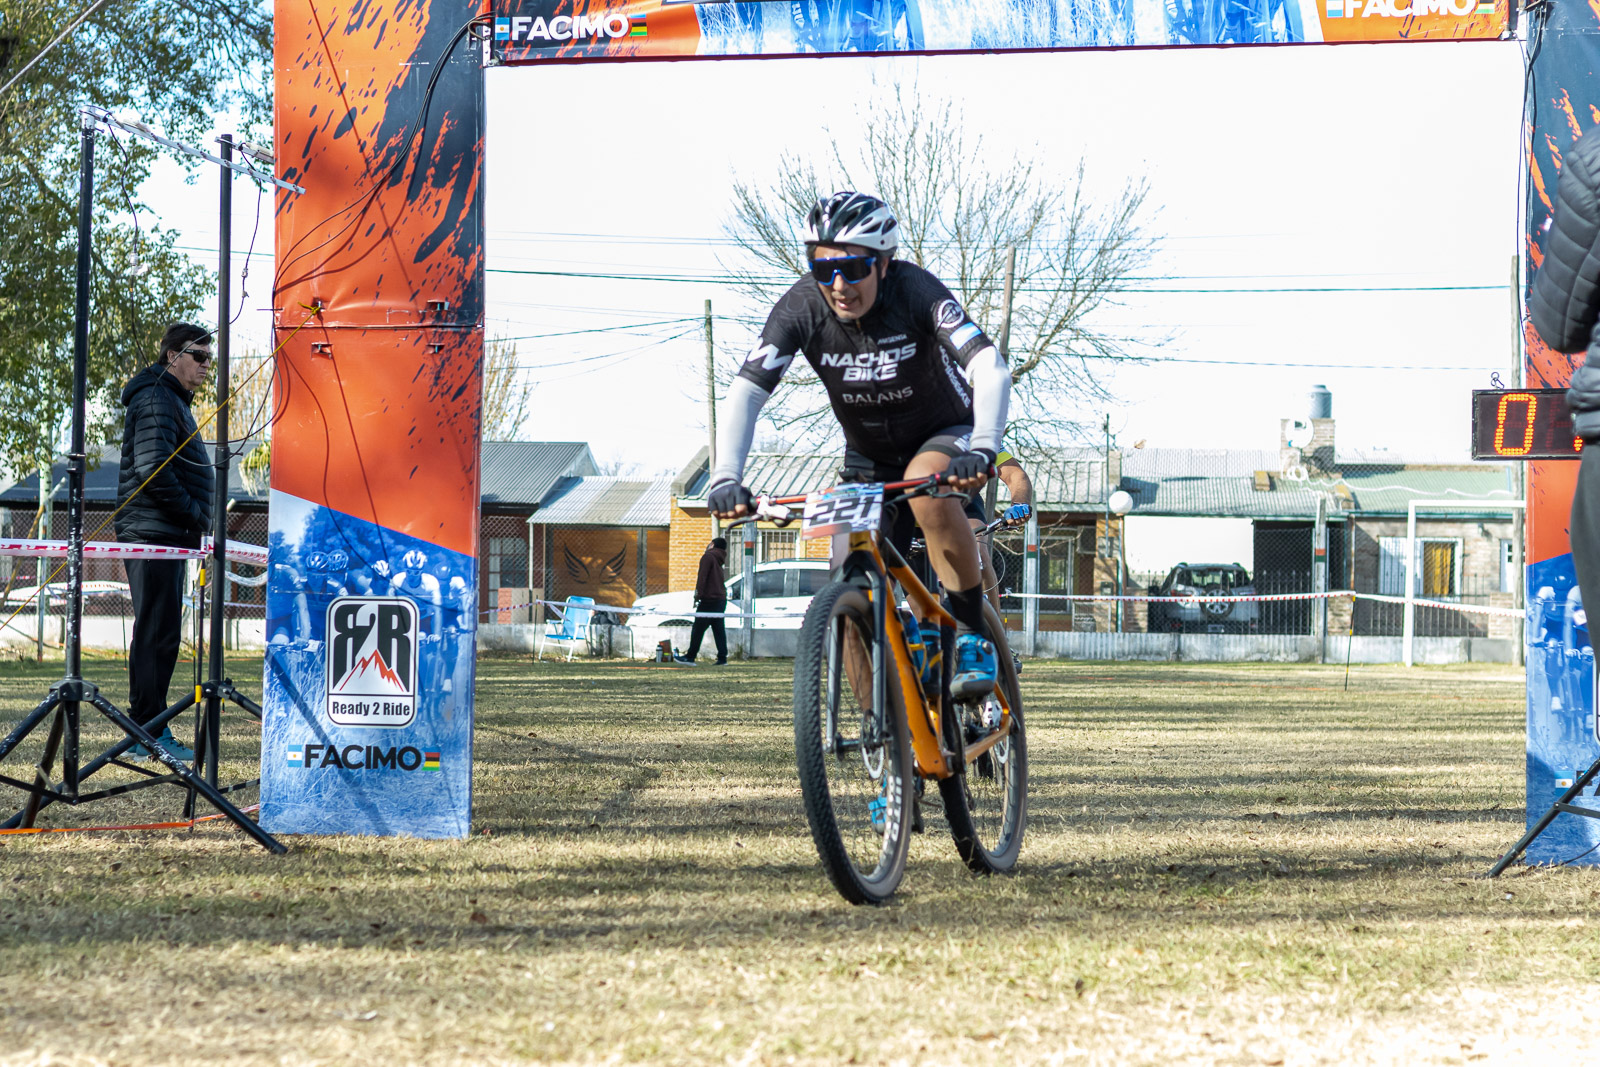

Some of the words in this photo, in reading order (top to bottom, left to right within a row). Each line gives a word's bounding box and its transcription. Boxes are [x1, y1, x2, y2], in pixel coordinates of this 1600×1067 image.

[1344, 0, 1476, 18] FACIMO
[511, 13, 630, 41] FACIMO
[820, 342, 917, 368] NACHOS
[842, 362, 899, 382] BIKE
[842, 386, 914, 404] BALANS
[808, 495, 876, 527] 221
[332, 701, 370, 717] Ready
[372, 701, 380, 716] 2
[383, 702, 410, 716] Ride
[304, 744, 422, 771] FACIMO
